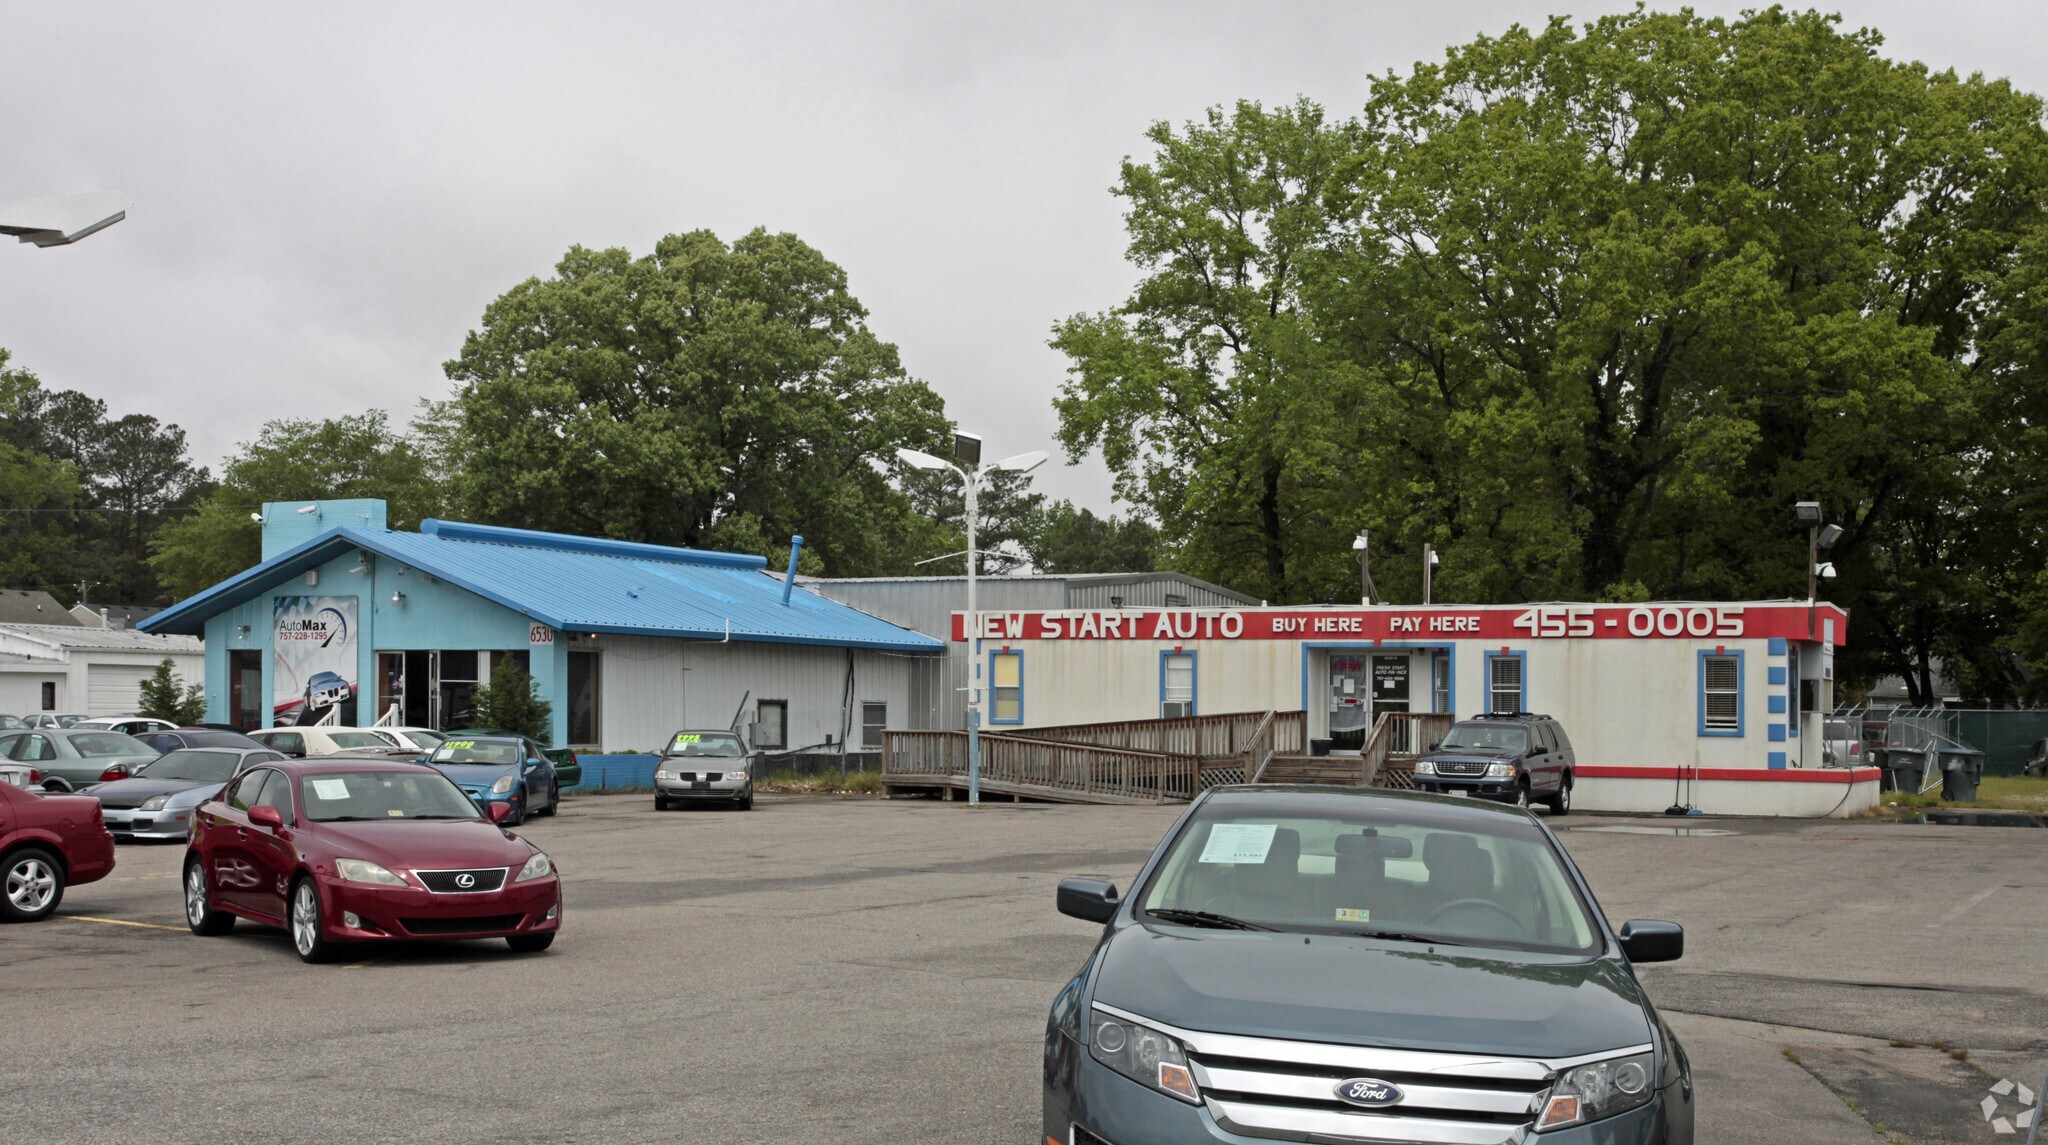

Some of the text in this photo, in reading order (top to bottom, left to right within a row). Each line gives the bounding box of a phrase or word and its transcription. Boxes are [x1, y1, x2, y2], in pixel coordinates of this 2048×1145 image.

[279, 620, 327, 631] AutoMax
[963, 611, 1244, 638] NEW START AUTO
[1272, 617, 1362, 632] BUY HERE
[1390, 616, 1480, 632] PAY HERE
[279, 632, 328, 640] 757-228-1295
[536, 626, 553, 642] 6530
[1333, 661, 1361, 671] OPEN
[1349, 1082, 1388, 1100] Ford
